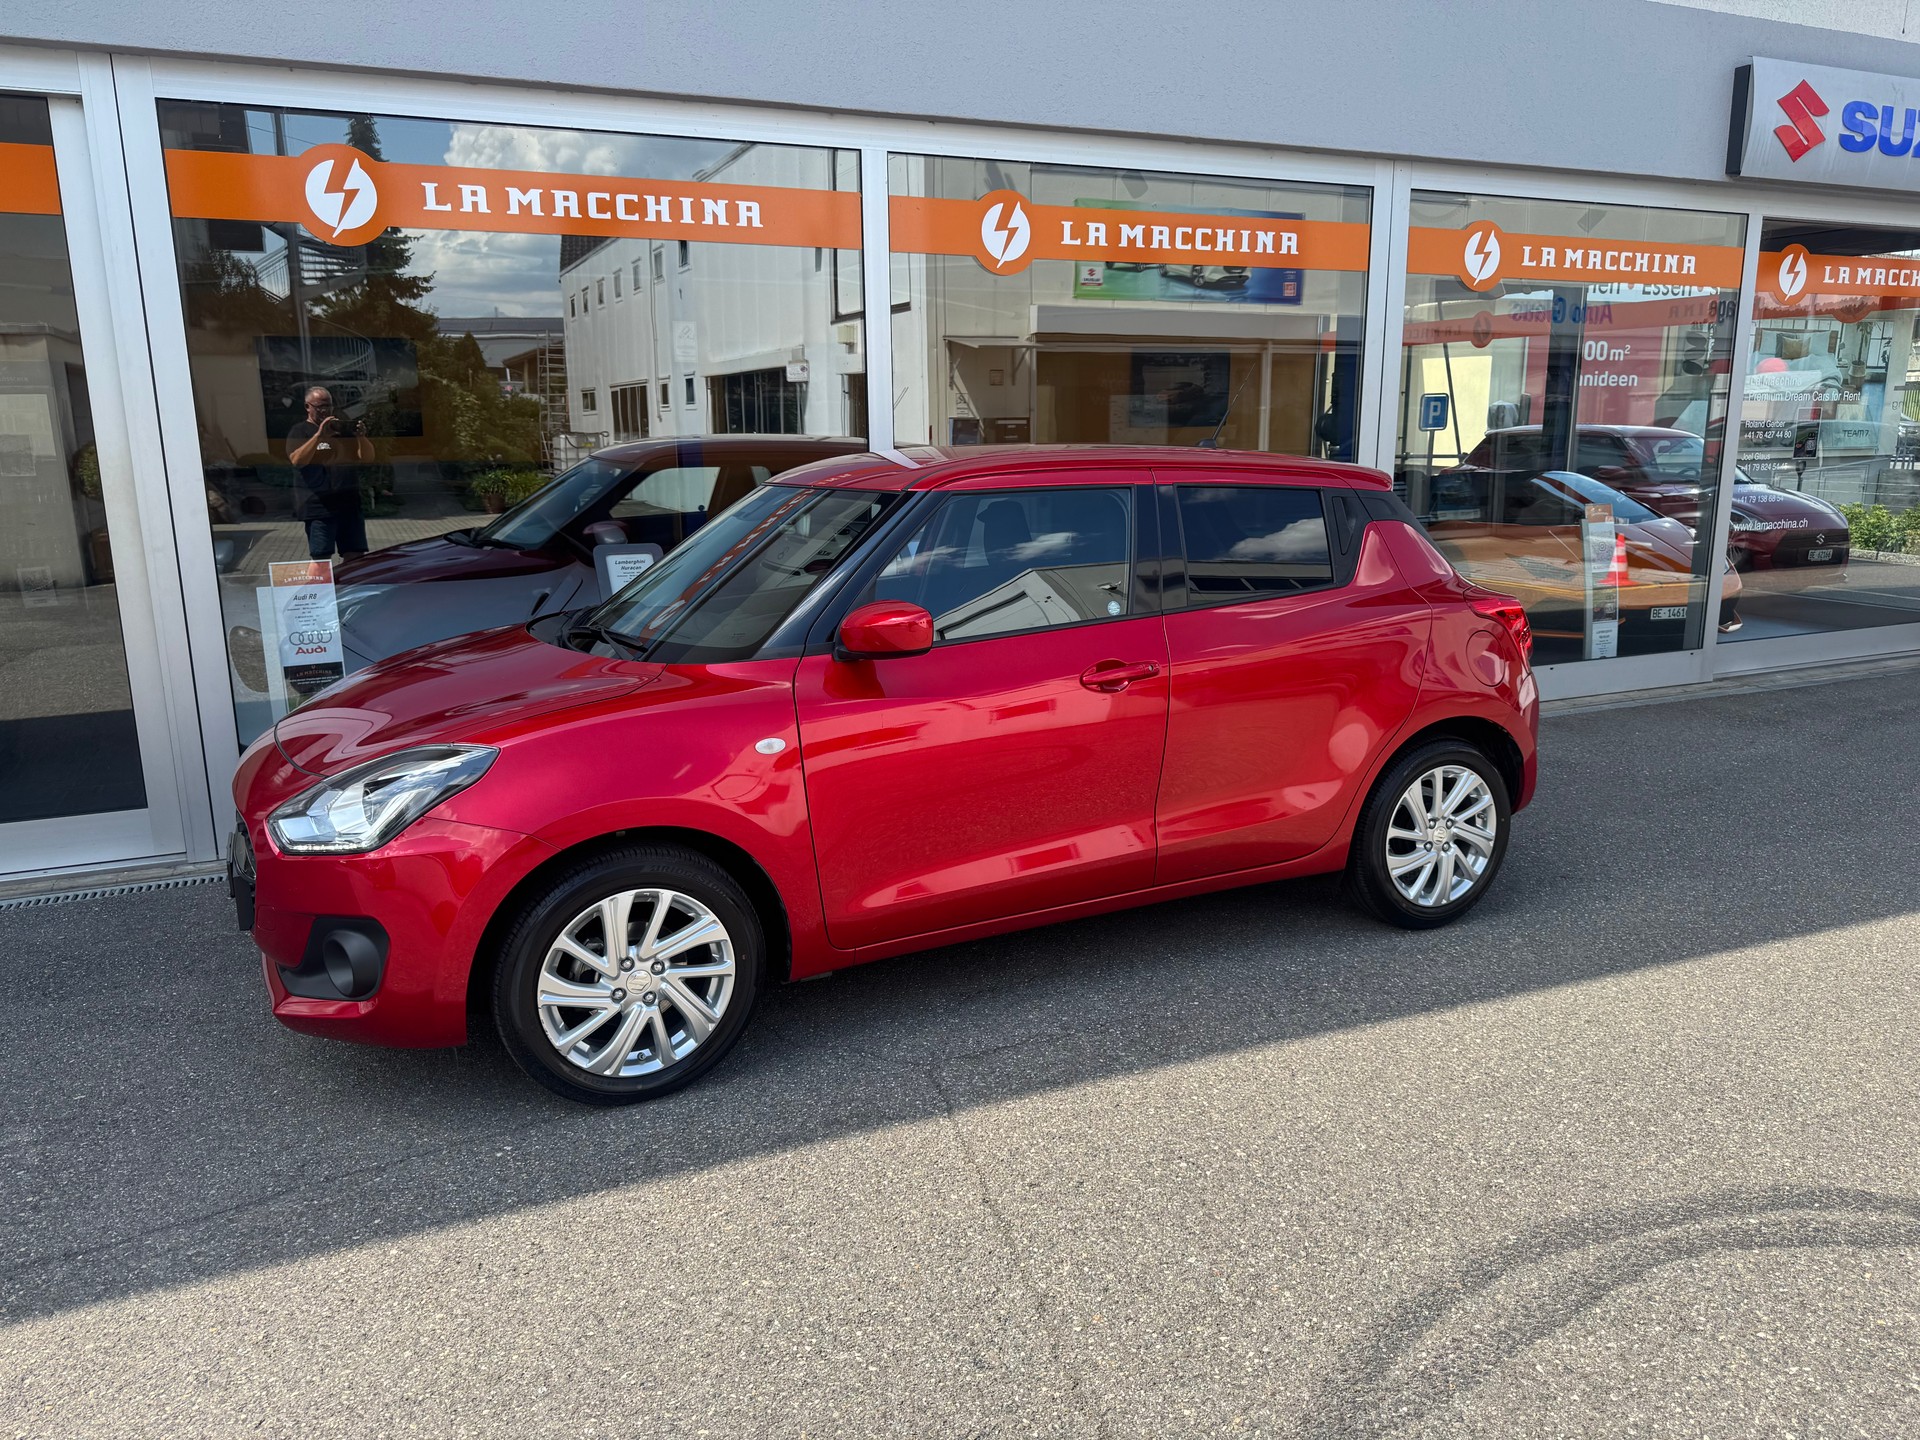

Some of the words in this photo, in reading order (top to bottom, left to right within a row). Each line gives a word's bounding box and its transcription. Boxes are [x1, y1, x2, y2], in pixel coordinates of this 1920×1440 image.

[1839, 101, 1920, 158] SU
[421, 182, 491, 213] LA
[505, 187, 763, 228] MACCHINA
[1061, 221, 1108, 246] LA
[1118, 223, 1299, 255] MACCHINA
[1521, 246, 1556, 267] LA
[1563, 248, 1696, 274] MACCHINA
[1823, 265, 1850, 283] LA
[1749, 392, 1783, 402] Premium
[1785, 391, 1810, 401] Dream
[1812, 391, 1830, 401] Cars
[1831, 391, 1842, 401] for
[1843, 391, 1861, 401] Rent
[1428, 401, 1442, 425] P
[1733, 517, 1809, 532] www.lamacchina.ch
[295, 645, 327, 655] Audi
